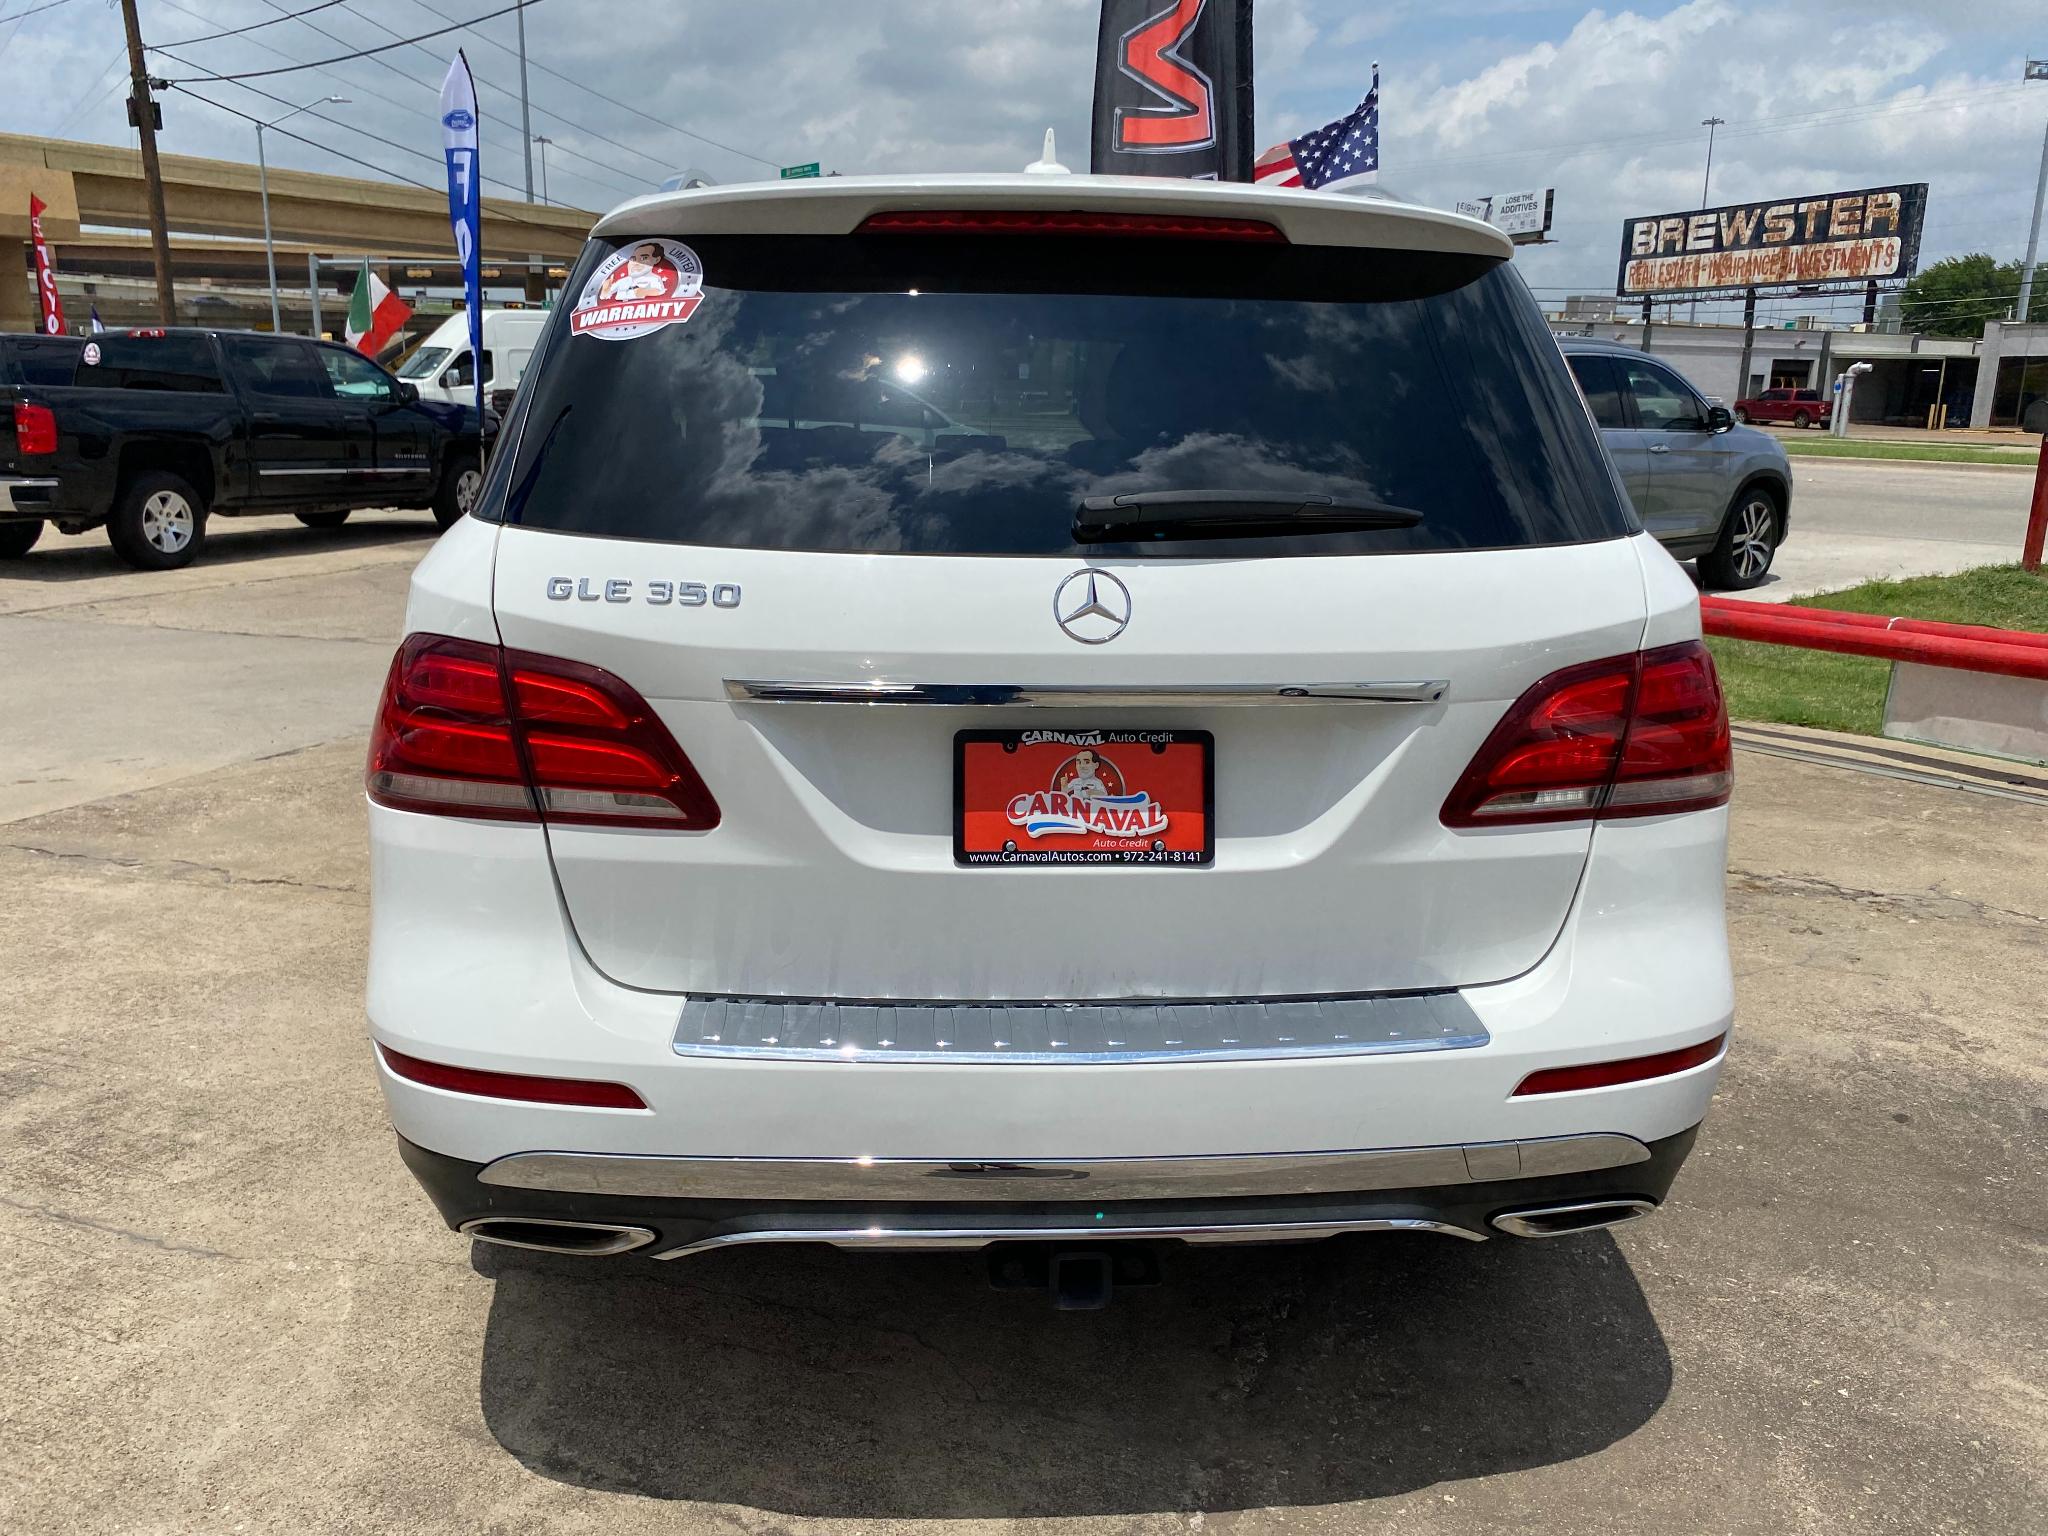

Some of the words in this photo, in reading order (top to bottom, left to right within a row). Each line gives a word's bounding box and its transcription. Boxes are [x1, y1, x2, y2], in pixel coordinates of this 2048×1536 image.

[1522, 193, 1534, 201] THE
[1500, 202, 1538, 214] ADDITIVES
[1631, 192, 1901, 256] BREWSTER
[601, 255, 623, 275] FREE
[669, 247, 695, 273] LIMITED
[1629, 263, 1655, 286] REAL
[579, 302, 686, 328] WARRANTY
[547, 577, 632, 603] GLE
[646, 581, 742, 608] 350
[1021, 730, 1105, 746] CARNAVAL
[1109, 733, 1136, 743] Auto
[1139, 732, 1174, 743] Credit
[1008, 793, 1167, 833] CARNAVAL
[1093, 839, 1117, 848] Auto
[1119, 839, 1148, 848] Credit
[969, 851, 1112, 862] www.CarnavalAutos.com
[1123, 852, 1201, 862] 972-241-8141
